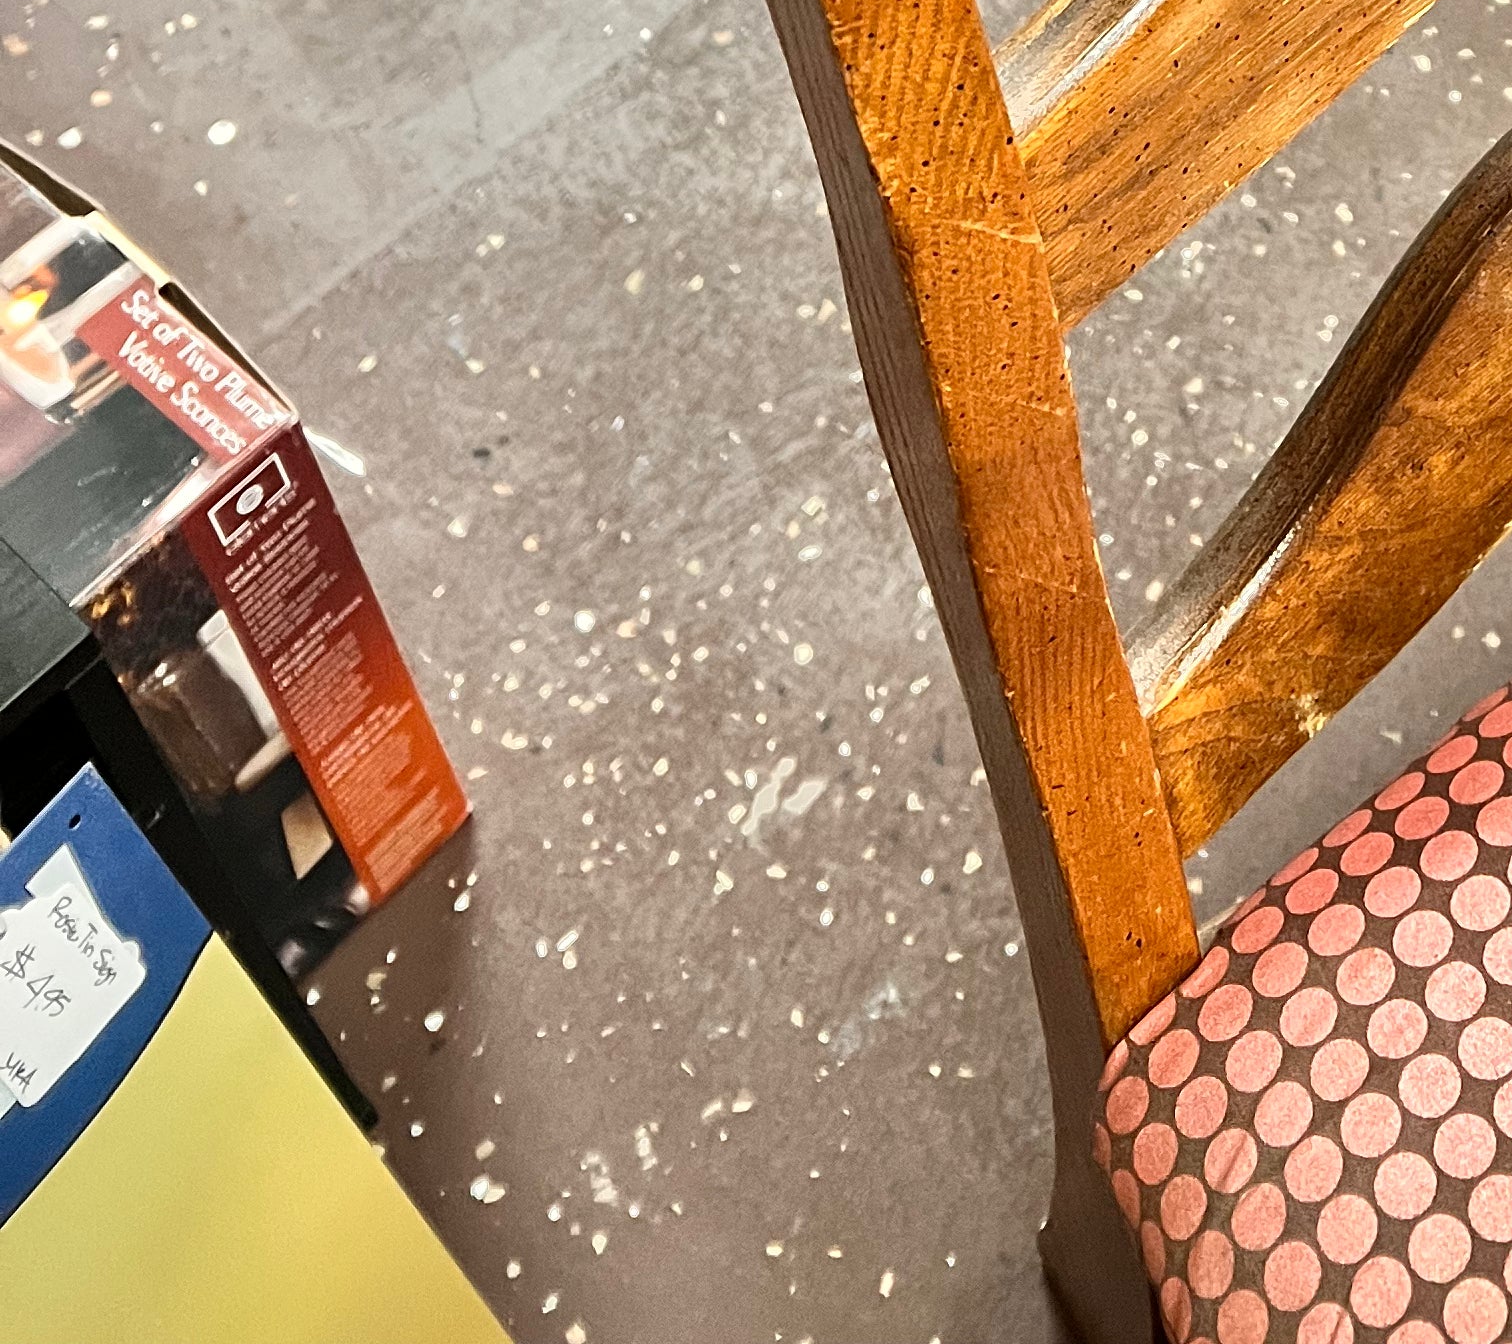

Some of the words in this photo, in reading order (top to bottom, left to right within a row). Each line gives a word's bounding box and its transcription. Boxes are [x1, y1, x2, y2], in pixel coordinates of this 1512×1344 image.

[118, 331, 176, 393] Votive
[170, 381, 247, 455] Sconces
[121, 290, 159, 329] Set
[152, 323, 189, 346] of
[177, 337, 218, 382] Two
[214, 371, 276, 429] Plume
[78, 923, 98, 957] Tin
[93, 949, 117, 986] Sign
